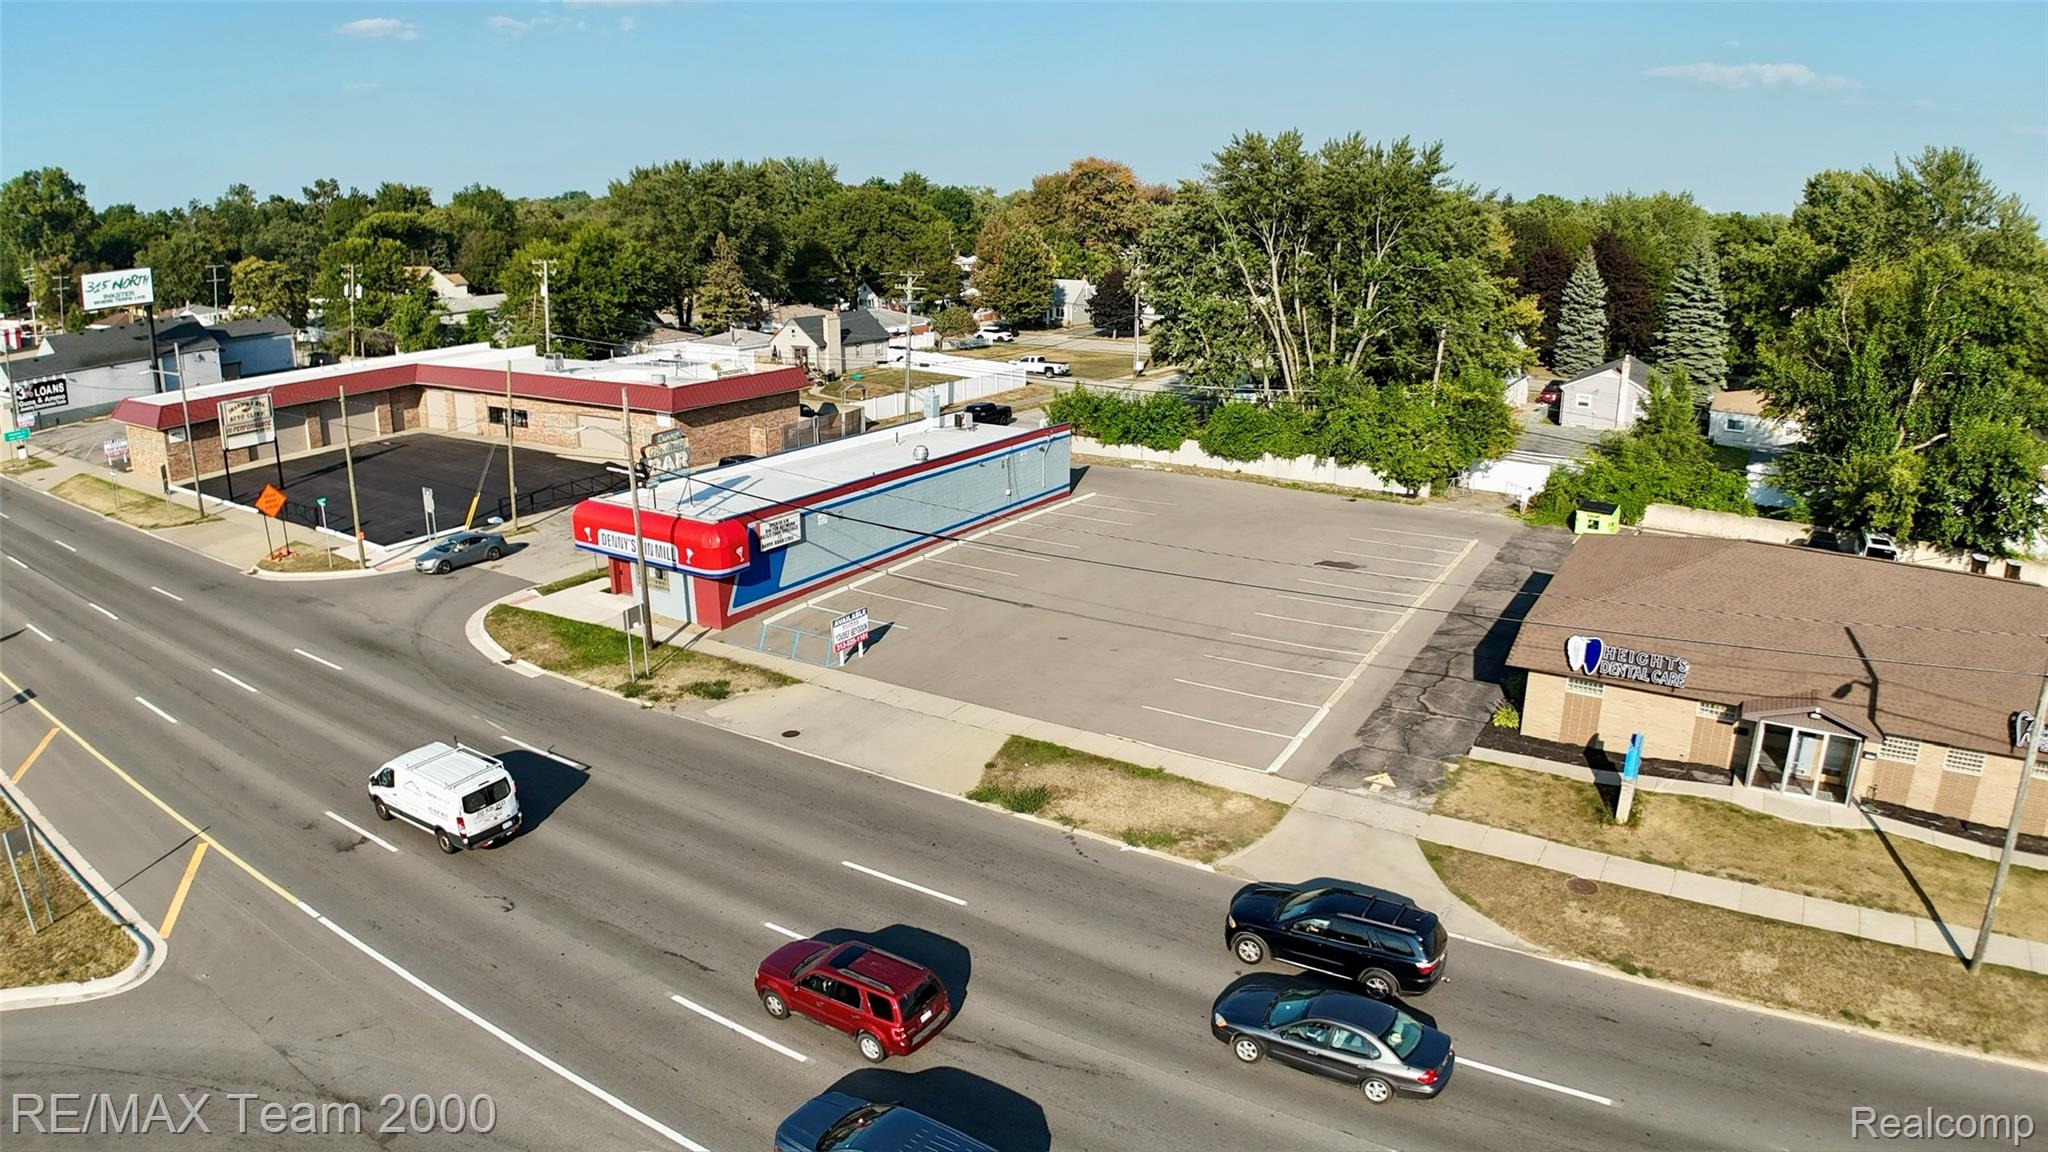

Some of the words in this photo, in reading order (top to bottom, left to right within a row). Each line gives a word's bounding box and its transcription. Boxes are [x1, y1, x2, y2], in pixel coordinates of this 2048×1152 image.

[112, 274, 149, 290] NORTH
[103, 291, 135, 299] INKSTER
[34, 382, 65, 397] LOANS
[648, 450, 689, 476] BAR
[601, 532, 637, 553] DENNY'S
[655, 544, 677, 562] MILL
[834, 608, 866, 626] AVAILABLE
[1603, 645, 1690, 673] HEIGHTS
[1600, 660, 1650, 683] DENTAL
[1650, 669, 1687, 689] CARE
